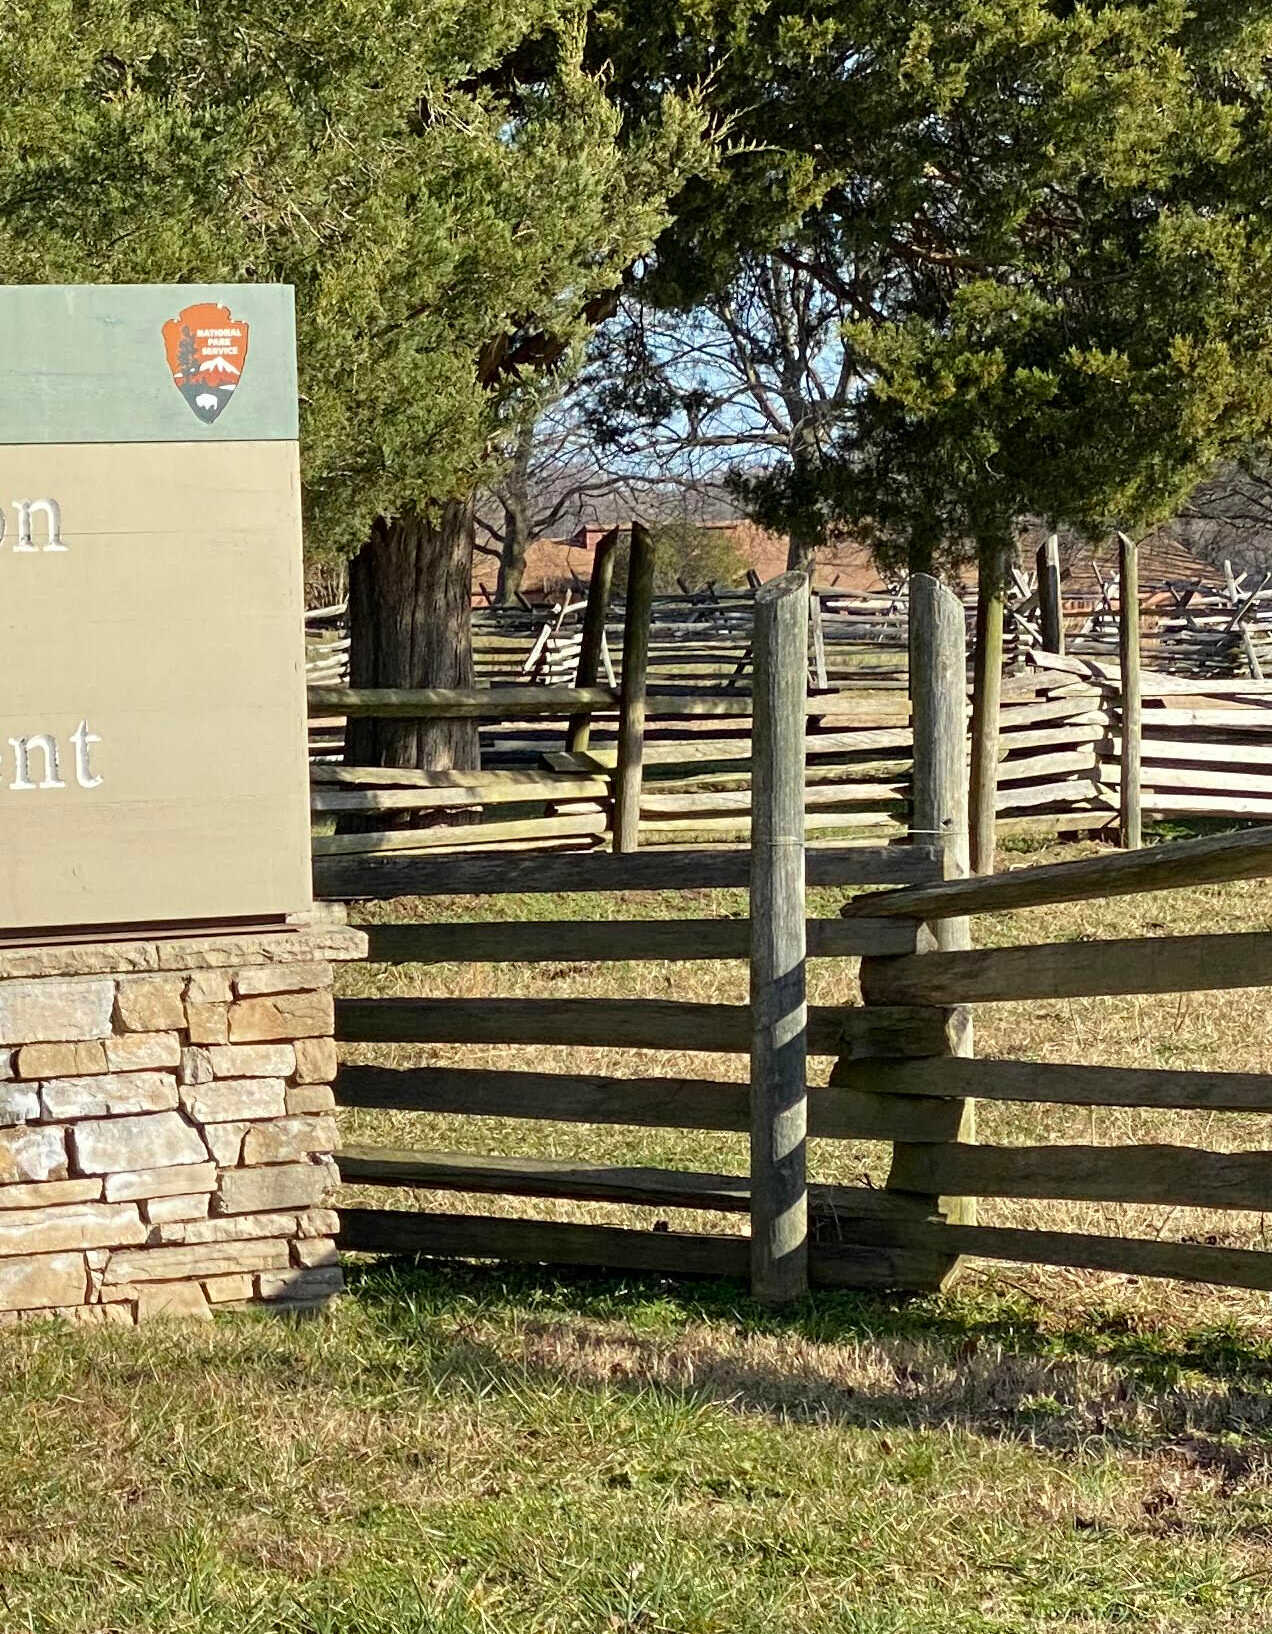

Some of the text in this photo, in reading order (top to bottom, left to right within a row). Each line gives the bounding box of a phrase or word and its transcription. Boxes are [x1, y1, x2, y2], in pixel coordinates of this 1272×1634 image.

[196, 328, 241, 337] NATIONAL
[207, 338, 232, 346] PARK
[201, 347, 239, 355] SERVICE
